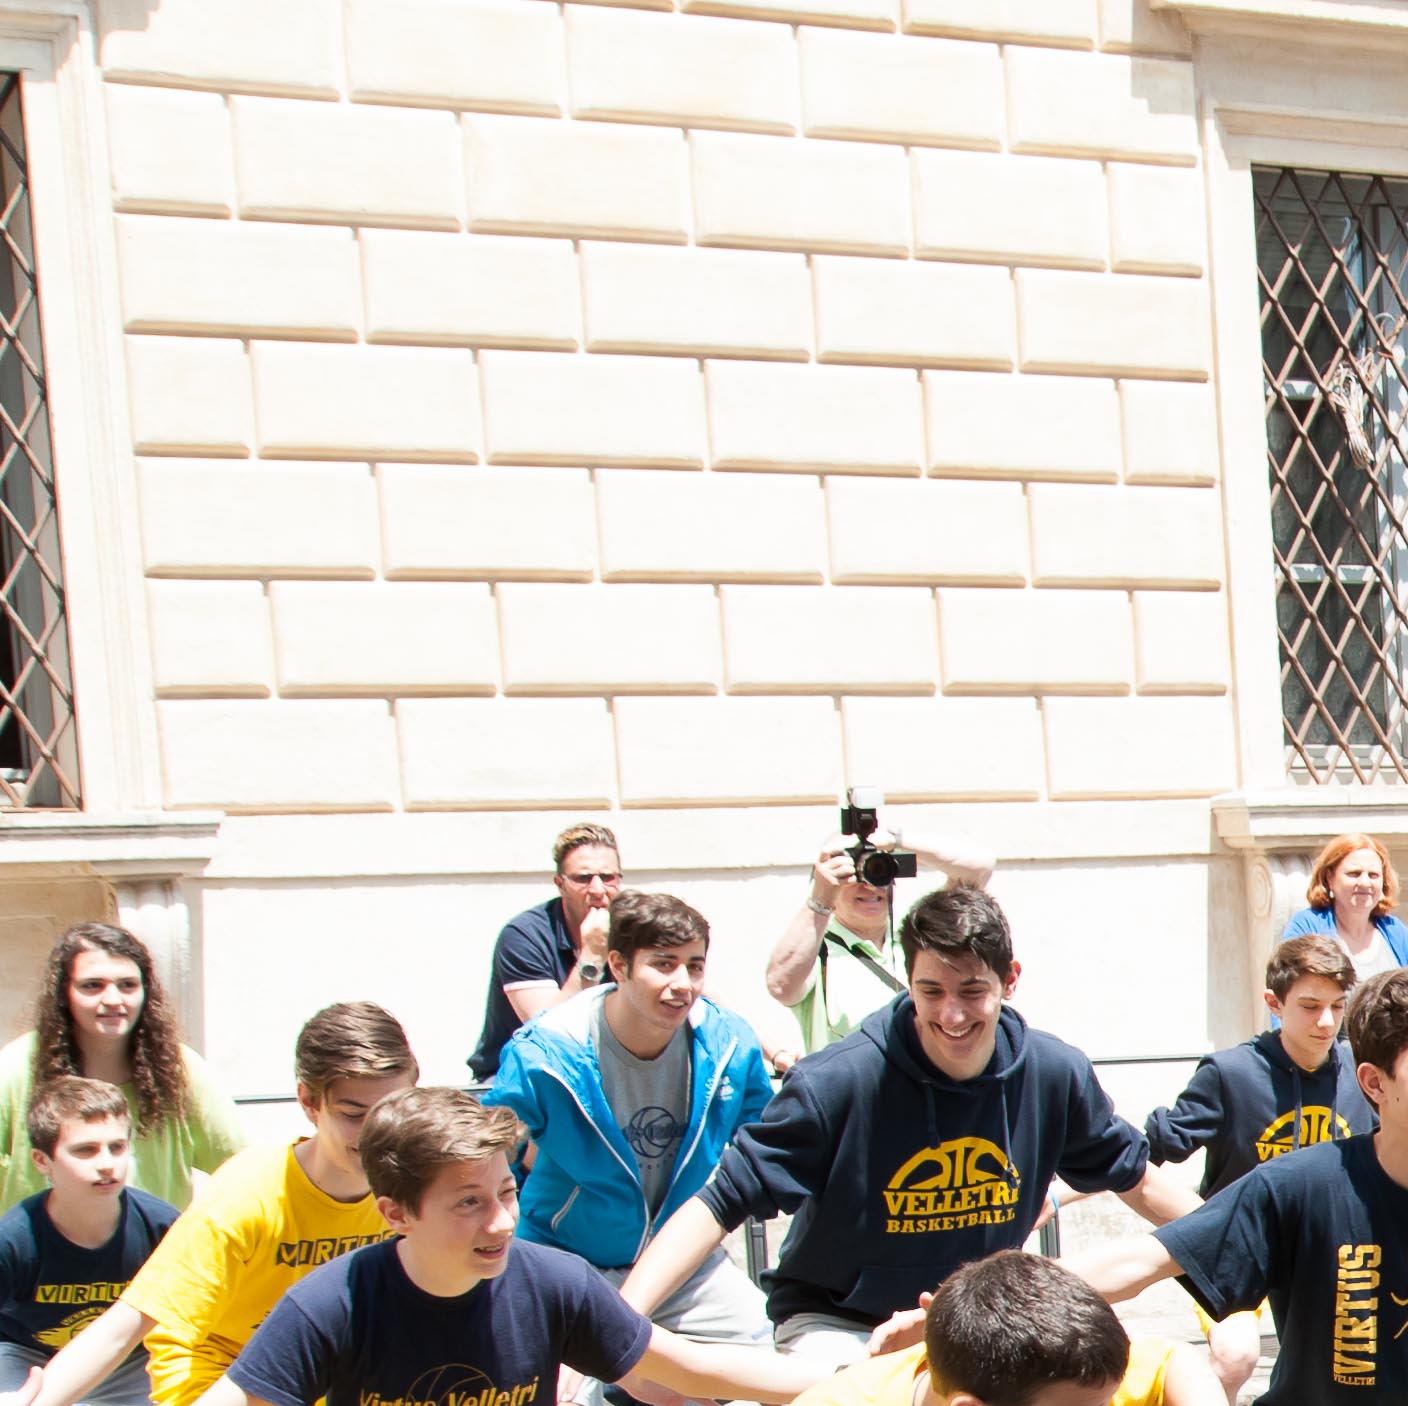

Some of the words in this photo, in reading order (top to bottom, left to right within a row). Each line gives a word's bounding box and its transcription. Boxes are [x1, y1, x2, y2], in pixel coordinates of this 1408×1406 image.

[883, 1182, 1020, 1216] VELLETRI
[886, 1208, 1016, 1233] BASKETBALL
[36, 1282, 131, 1304] VIRTU
[1333, 1244, 1382, 1374] VIRTUS
[1333, 1374, 1376, 1386] VELLETRI
